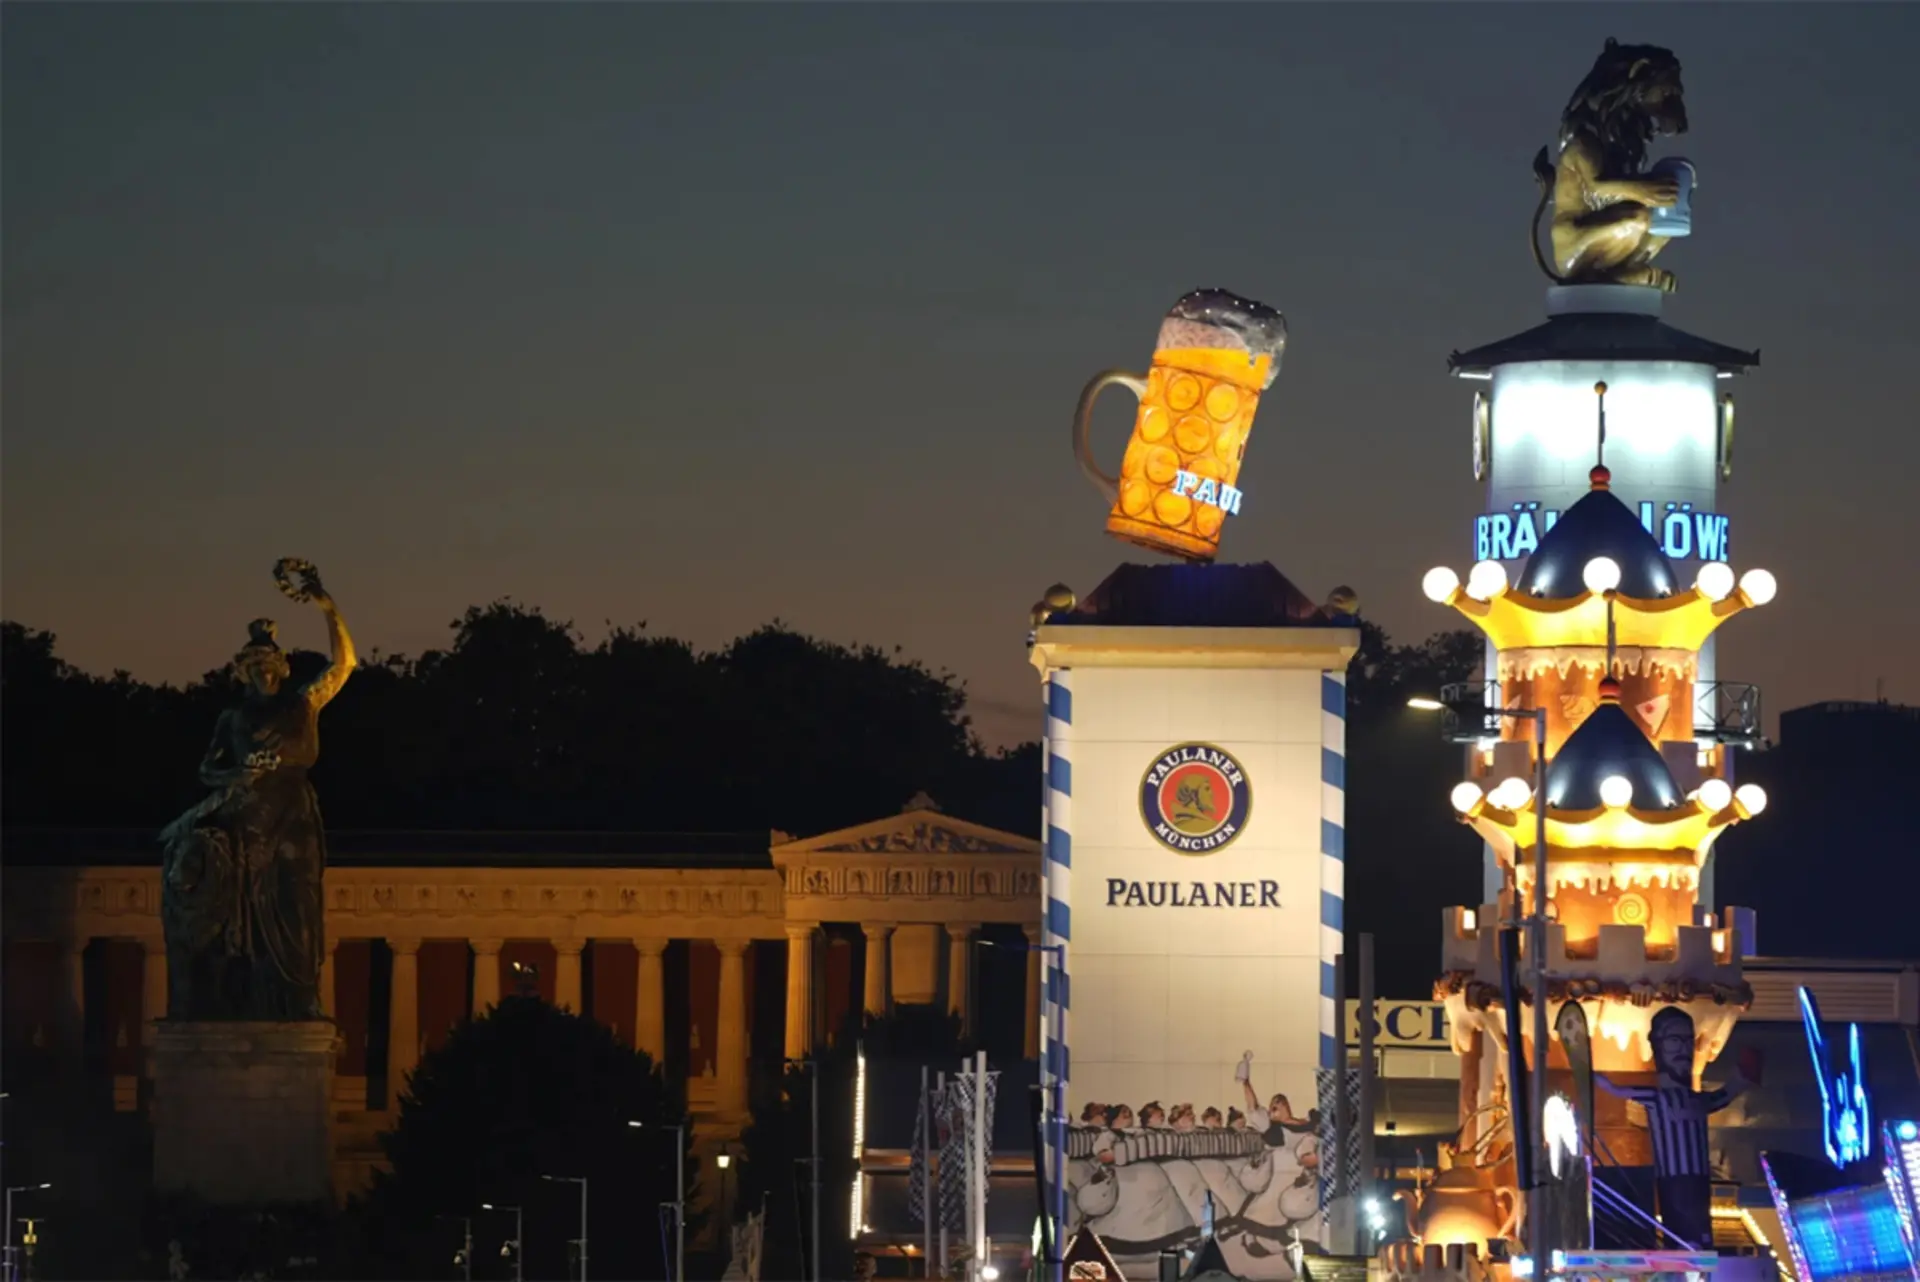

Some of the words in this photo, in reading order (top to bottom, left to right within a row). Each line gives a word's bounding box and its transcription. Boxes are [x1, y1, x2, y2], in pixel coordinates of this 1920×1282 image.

[1476, 502, 1558, 561] BRÄ
[1146, 747, 1244, 787] PAULANER
[1155, 821, 1236, 850] MÜNCHEN
[1105, 877, 1282, 908] PAULANER
